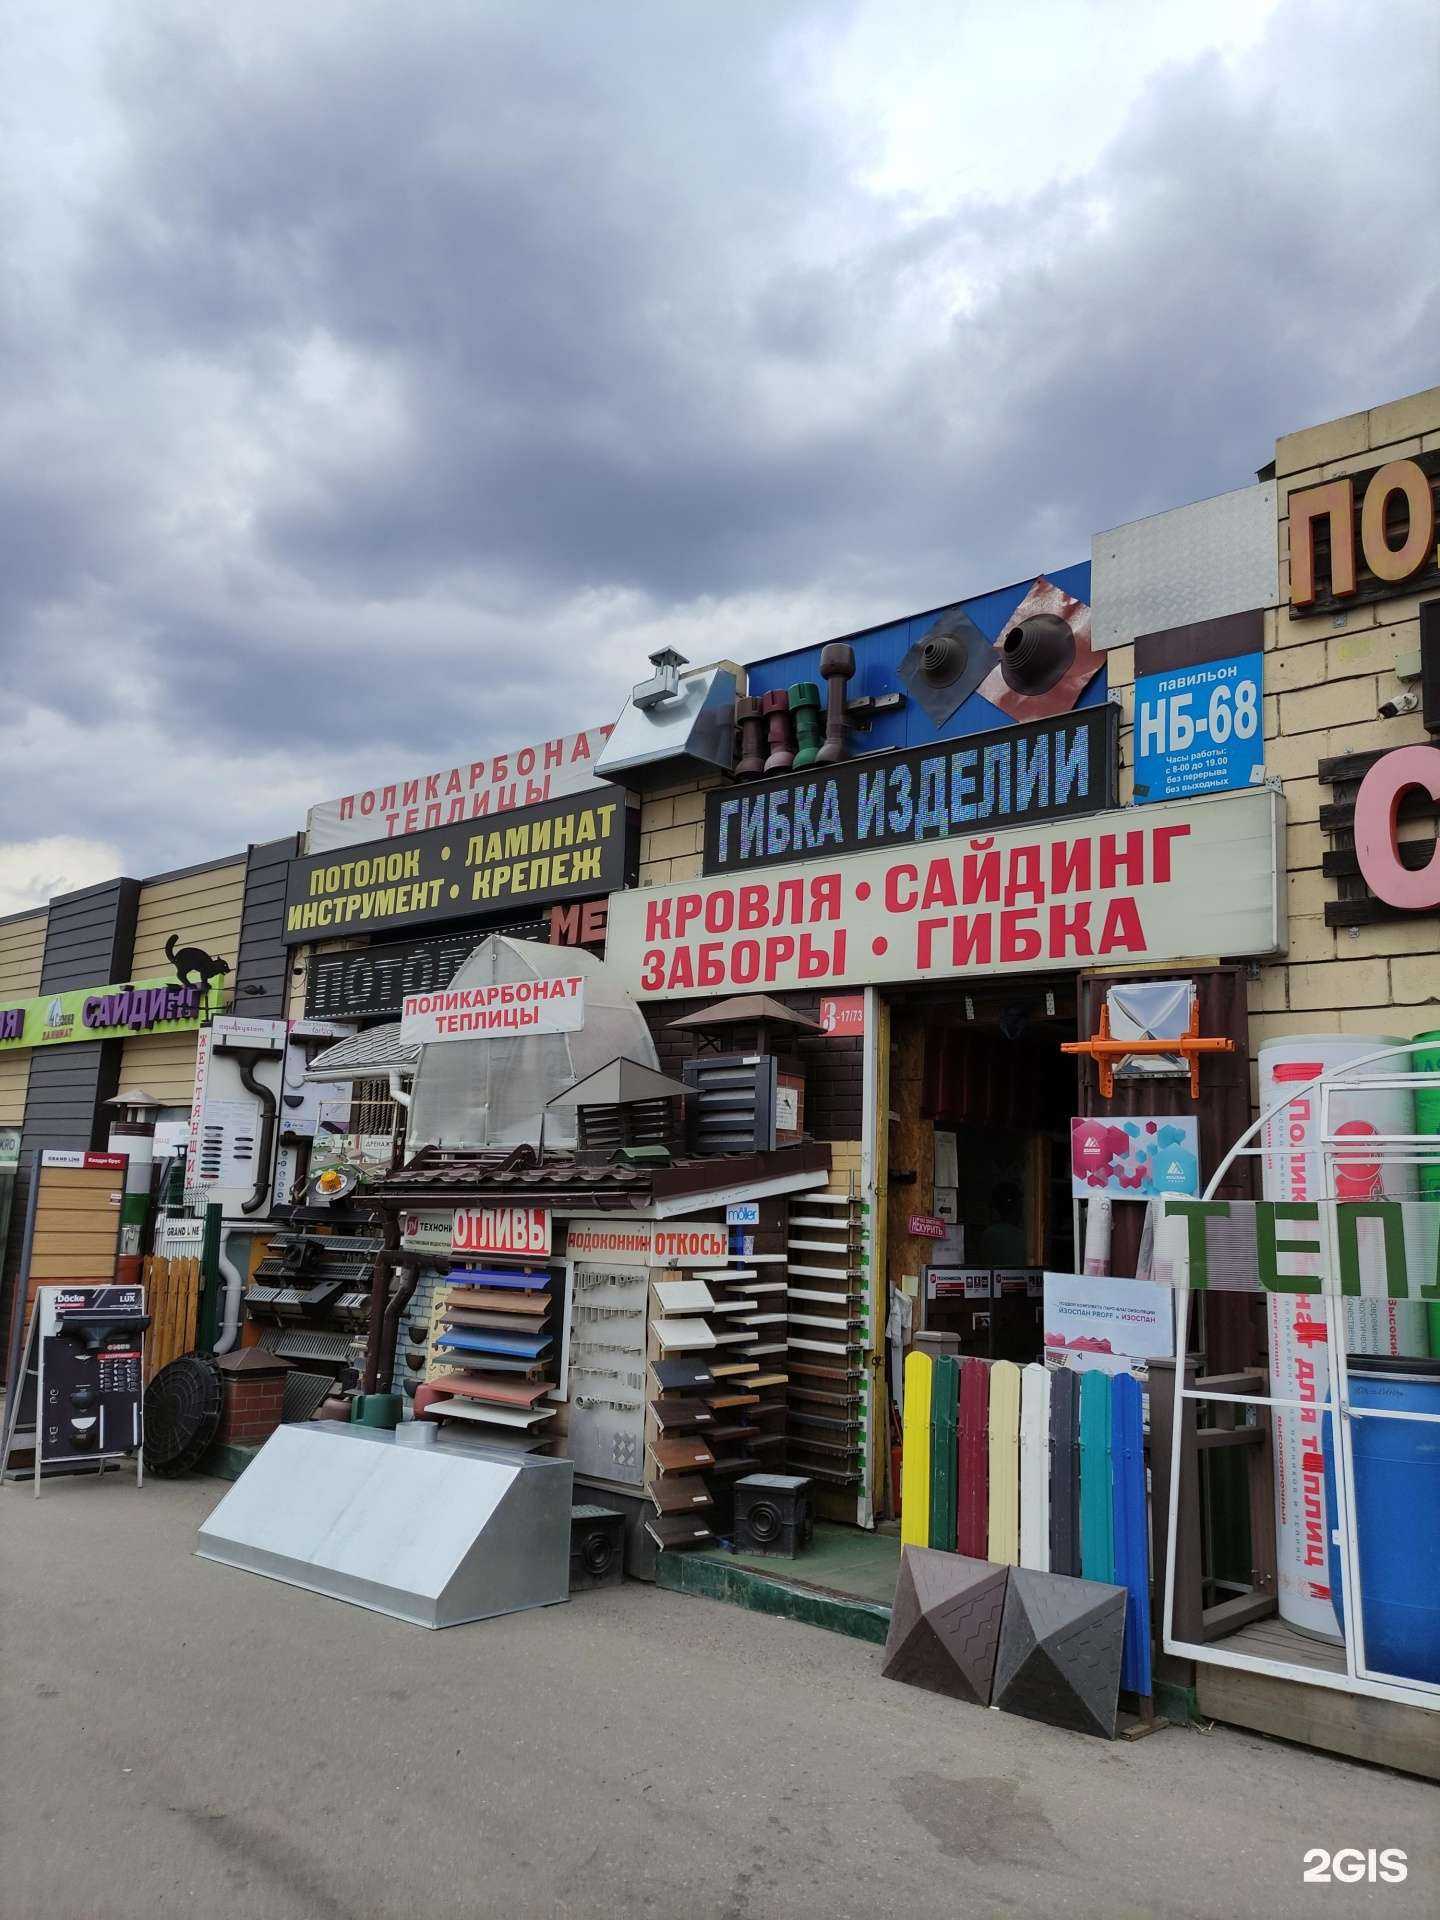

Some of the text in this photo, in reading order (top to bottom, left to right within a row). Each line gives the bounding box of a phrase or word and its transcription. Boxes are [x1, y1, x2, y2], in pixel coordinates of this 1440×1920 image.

[1289, 458, 1440, 608] ПО
[1158, 666, 1238, 692] павильон
[1140, 680, 1258, 757] НБ-68
[1166, 748, 1227, 763] Часы работы:
[1192, 761, 1203, 770] до
[1206, 757, 1228, 767] 19.00
[1165, 778, 1229, 794] без выходных
[1166, 768, 1227, 784] без перерыва
[385, 775, 550, 838] ТЕПЛИЦЫ
[718, 724, 1090, 862] ГИБКА ИЗДЕЛИИ
[310, 803, 617, 896] ПОТОЛОК ЛАМИНАТ
[287, 846, 602, 931] ИНСТРУМЕНТ КРЕПЕЖ
[645, 824, 1192, 942] КРОВЛЯ САЙДИНГ
[642, 896, 1148, 992] ЗАБОРЫ ГИБКА
[405, 976, 583, 1016] ПОЛИКАРБОНАТ
[435, 1006, 540, 1034] ТЕПЛИЦЫ
[365, 1140, 390, 1148] ДРЕНА
[187, 1226, 200, 1236] LNE
[453, 1208, 551, 1251] ОТЛИВЫ
[655, 1232, 728, 1256] ОТКОСЫ
[120, 1295, 135, 1303] LUX
[1058, 1308, 1091, 1317] ИЗОСПАН
[1121, 1314, 1156, 1324] ИЗОСПАН
